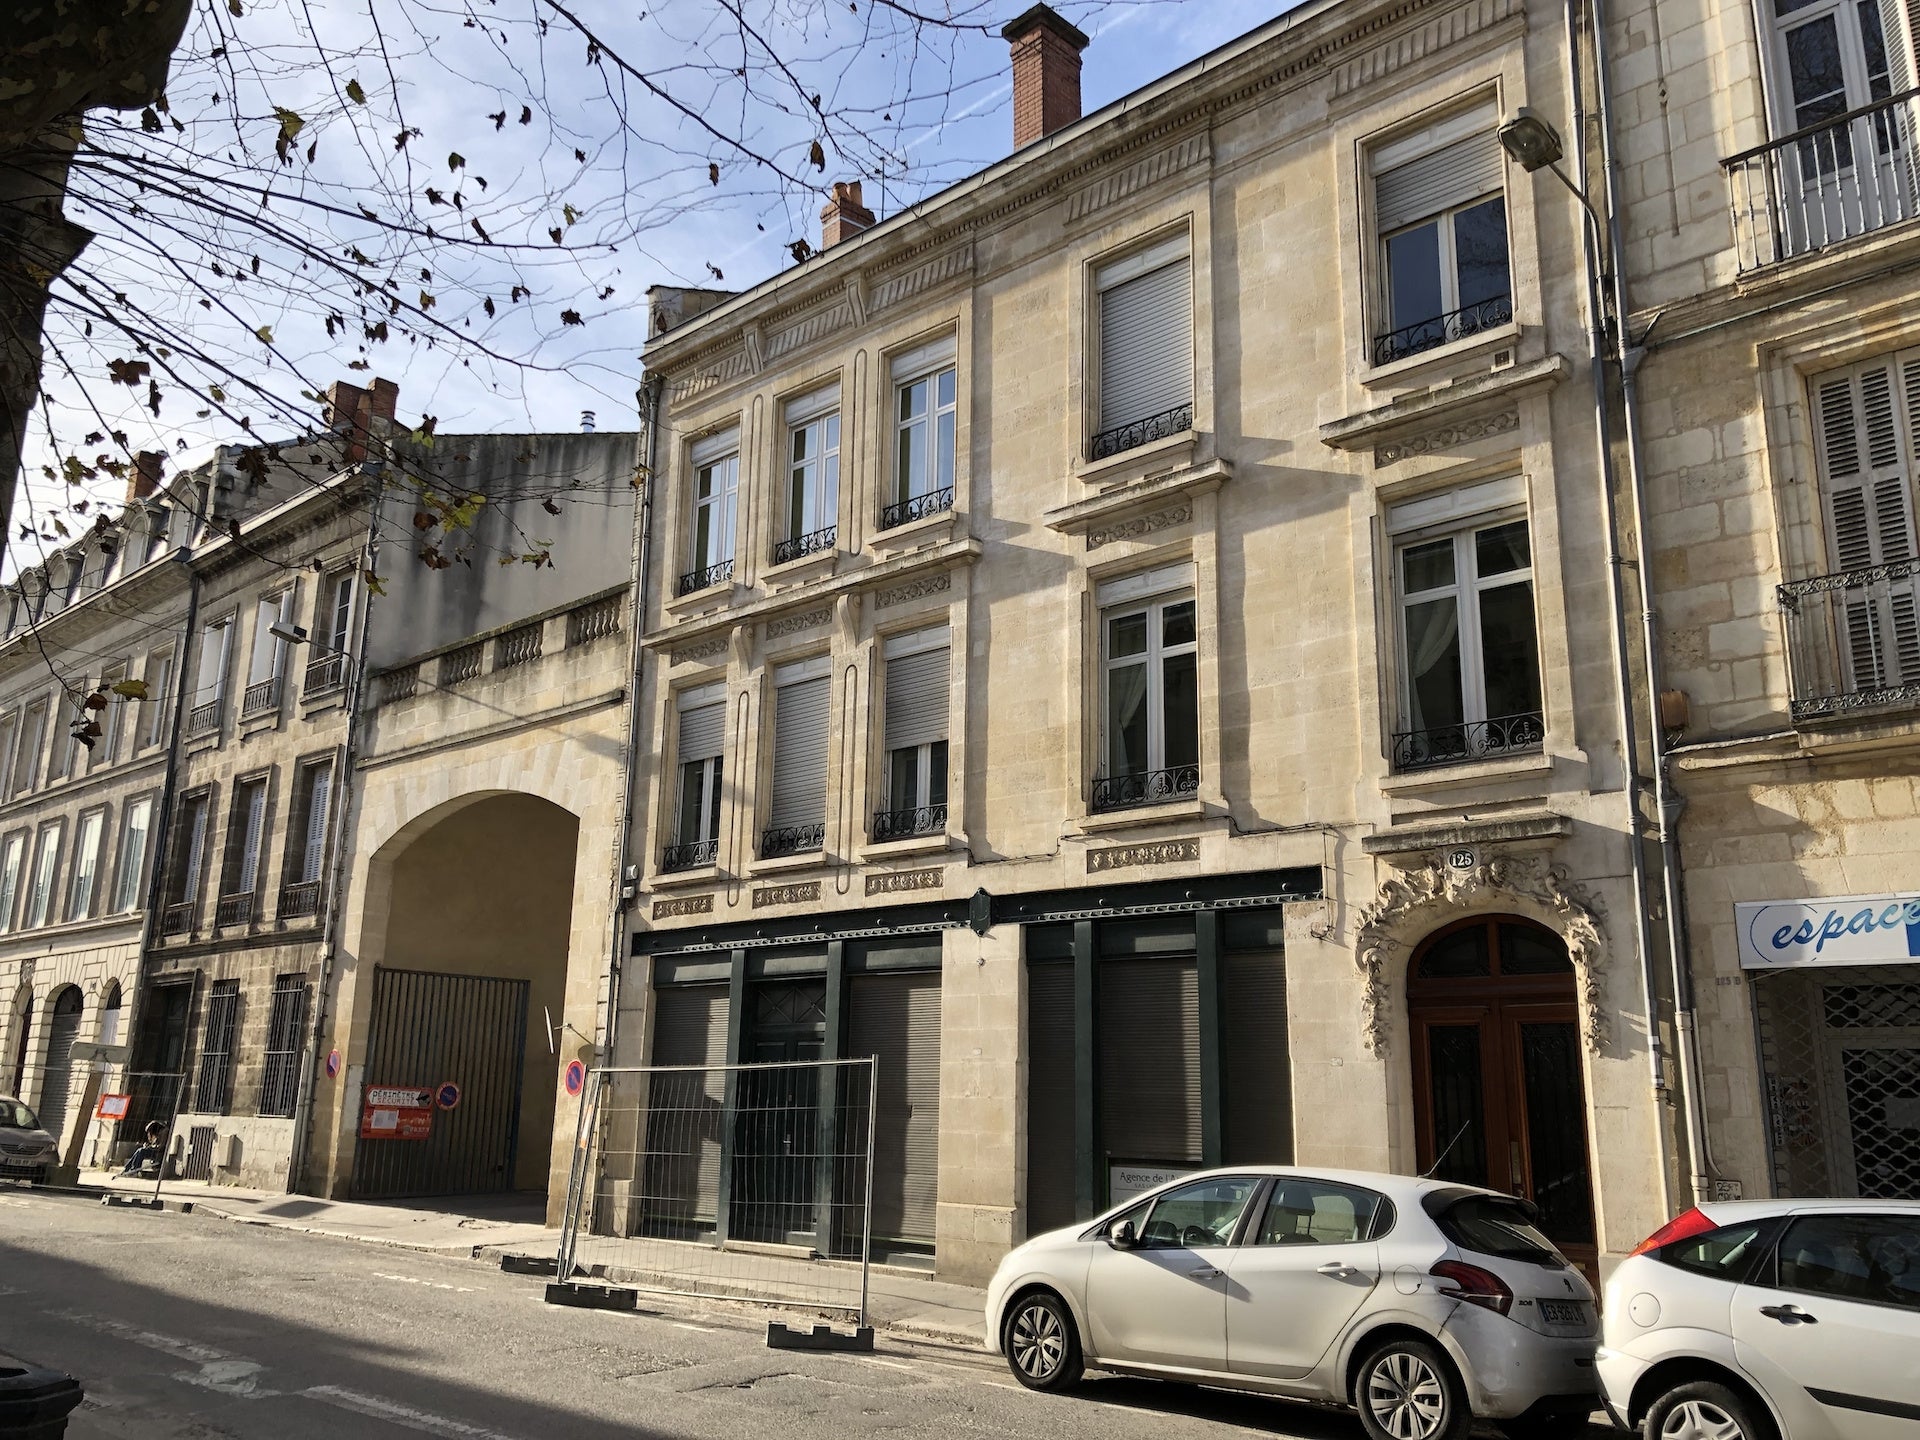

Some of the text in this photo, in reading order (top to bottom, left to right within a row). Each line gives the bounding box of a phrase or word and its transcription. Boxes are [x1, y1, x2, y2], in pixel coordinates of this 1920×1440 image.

[1451, 853, 1472, 866] 125
[1120, 1171, 1151, 1183] Agence
[1152, 1173, 1163, 1182] de
